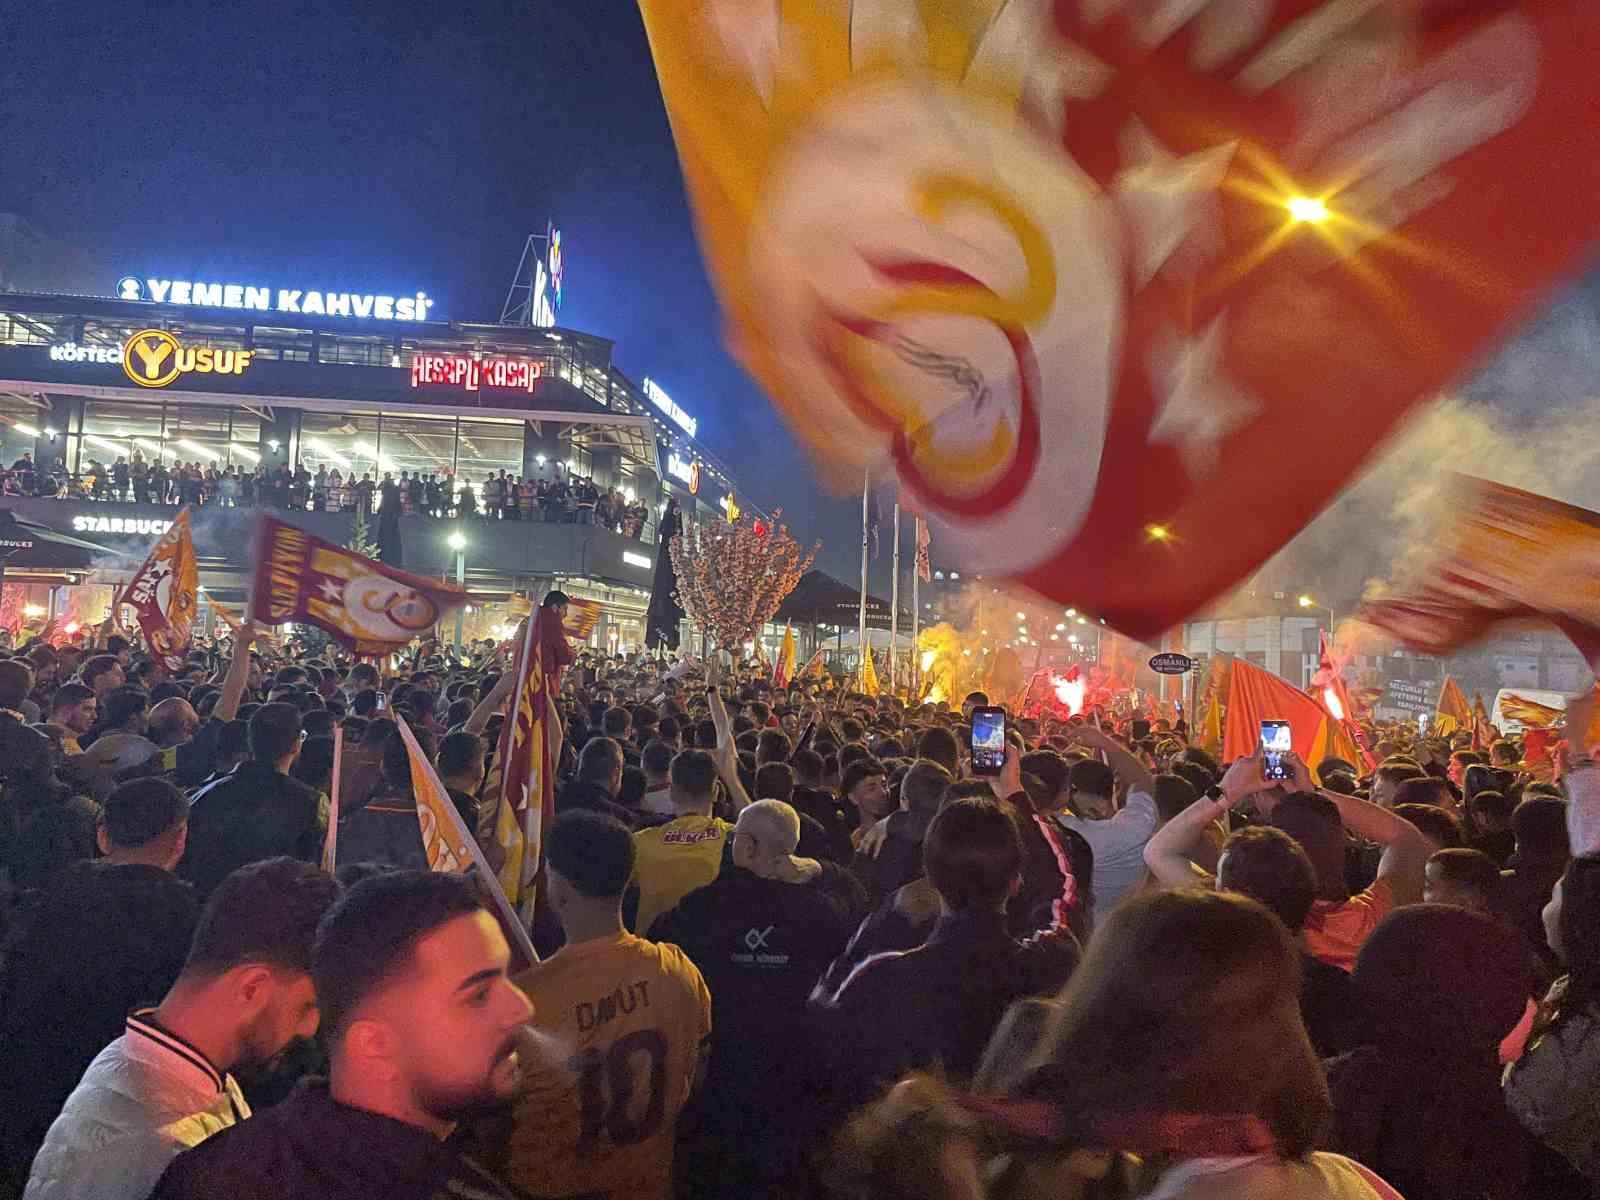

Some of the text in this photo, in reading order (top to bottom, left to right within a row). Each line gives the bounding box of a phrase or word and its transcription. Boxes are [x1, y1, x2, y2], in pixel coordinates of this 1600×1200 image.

[148, 279, 270, 309] YEMEN
[134, 339, 251, 379] YUSUF
[482, 360, 541, 393] KASAP
